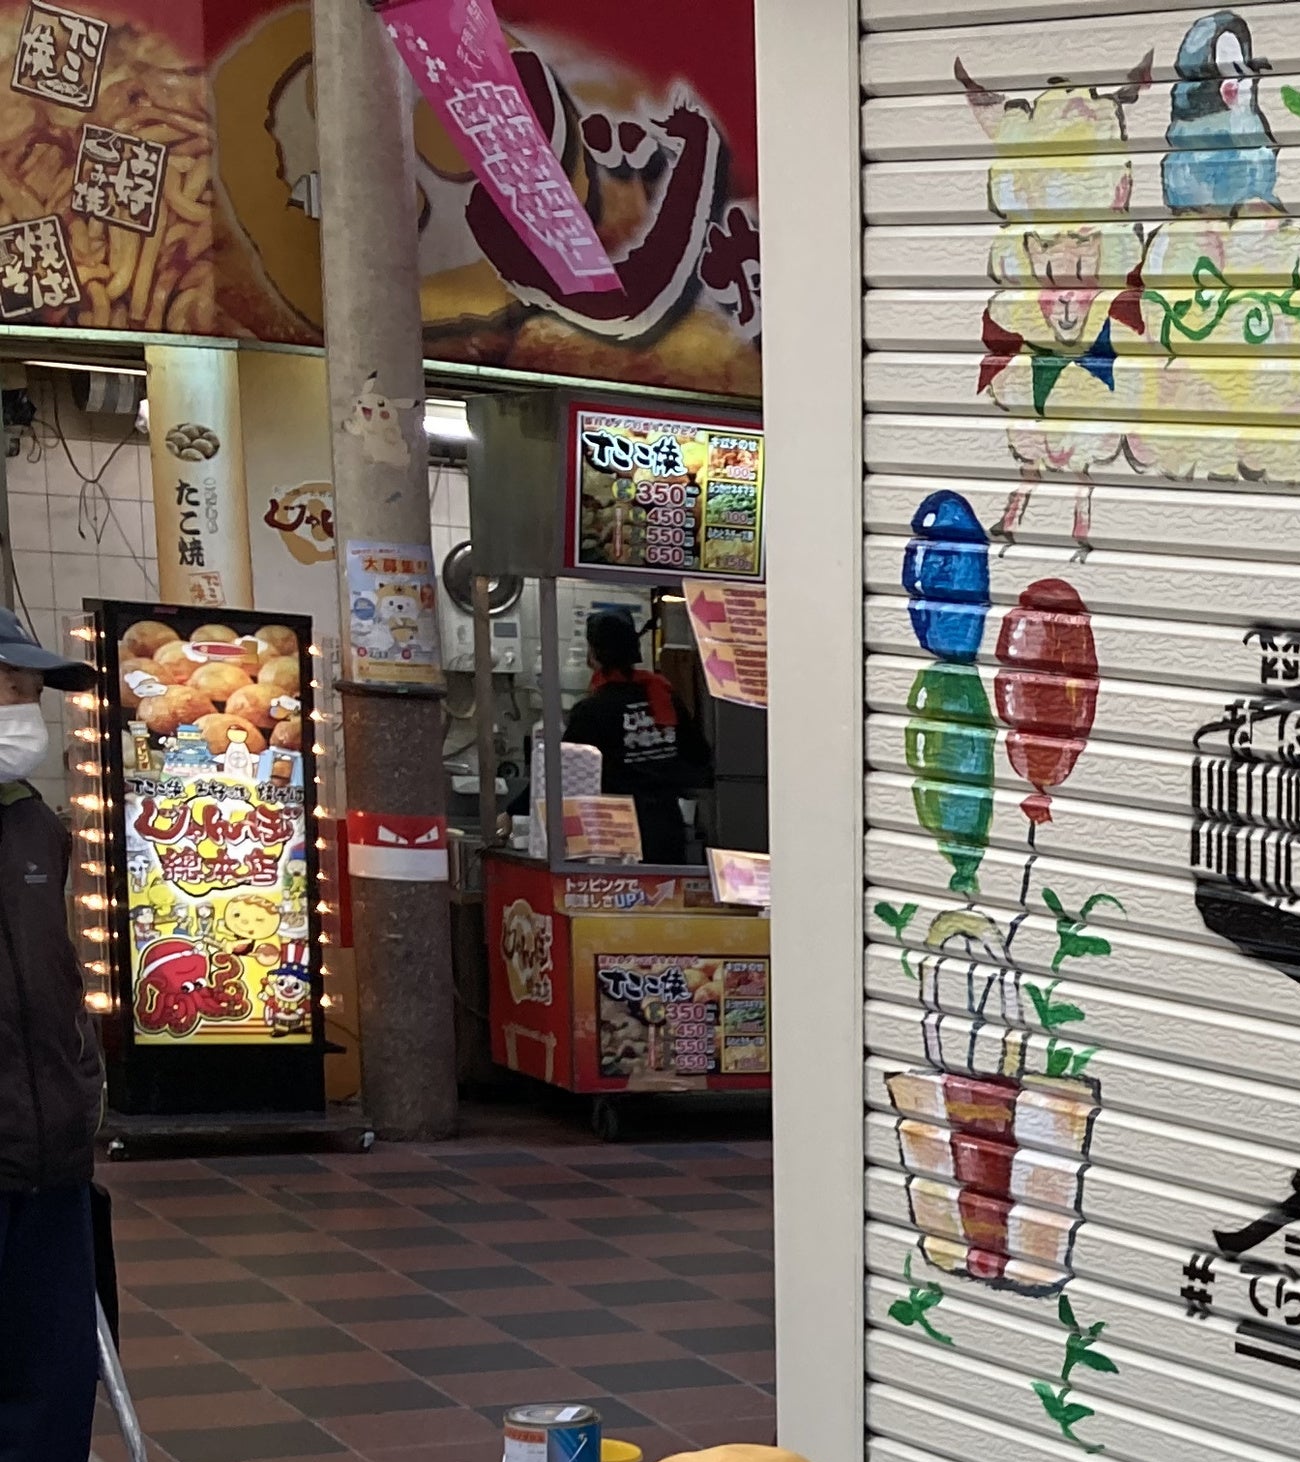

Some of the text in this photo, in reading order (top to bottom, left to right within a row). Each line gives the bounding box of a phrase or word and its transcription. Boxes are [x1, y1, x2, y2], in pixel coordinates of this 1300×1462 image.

[21, 16, 99, 81] たこ焼
[583, 431, 687, 476] たこ焼
[176, 479, 205, 567] たこ焼
[566, 878, 640, 892] トッピングで
[599, 966, 692, 1001] たこ焼
